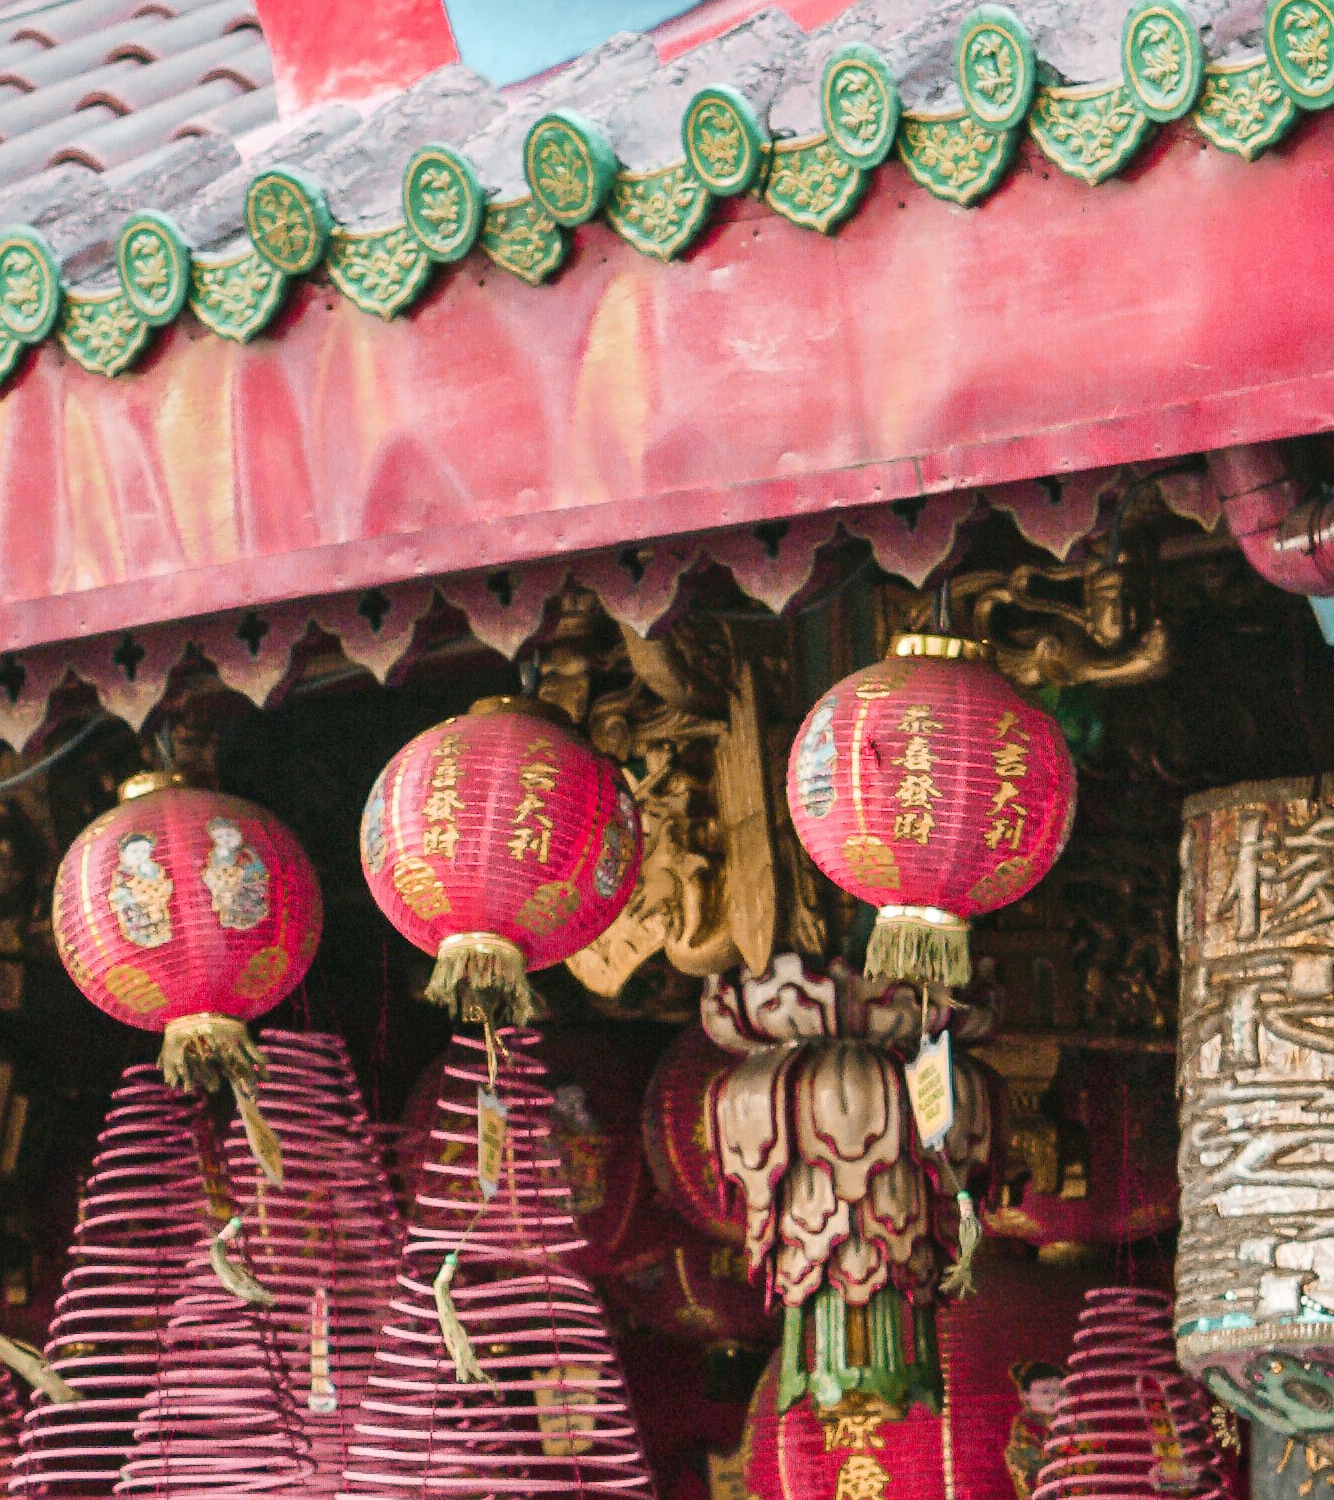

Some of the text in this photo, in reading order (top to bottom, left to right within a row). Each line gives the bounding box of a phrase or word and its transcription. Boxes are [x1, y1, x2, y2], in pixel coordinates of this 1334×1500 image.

[422, 734, 471, 859] 恭喜發財
[507, 735, 560, 864] 大吉大利
[891, 704, 944, 846] 恭喜發財
[983, 710, 1031, 850] 大吉大利
